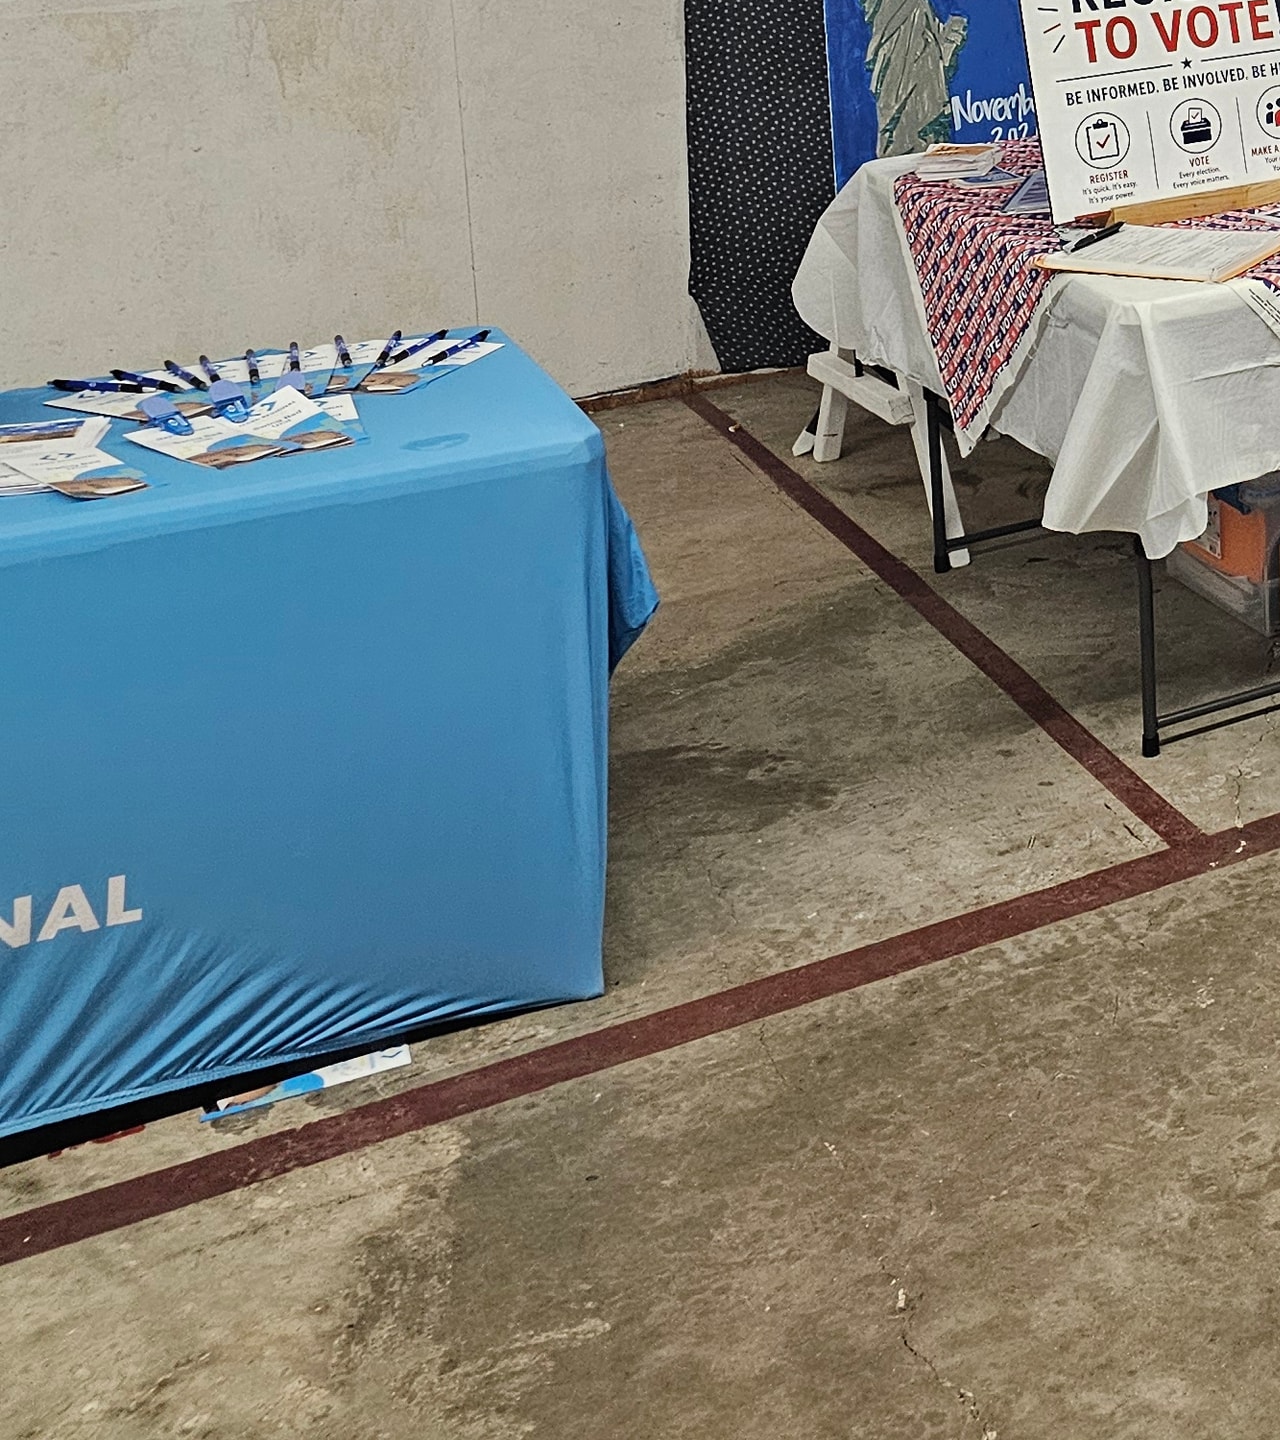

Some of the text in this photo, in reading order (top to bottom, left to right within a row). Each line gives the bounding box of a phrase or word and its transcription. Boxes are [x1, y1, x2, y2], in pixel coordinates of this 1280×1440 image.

[1074, 15, 1138, 63] TO
[1065, 90, 1083, 106] BE
[1086, 80, 1159, 102] INFORMED.
[1162, 77, 1180, 92] BE
[1182, 67, 1249, 91] INVOLVED.
[1252, 64, 1268, 79] BE
[951, 83, 1035, 131] Novemb
[1251, 144, 1272, 157] MAKE
[1274, 143, 1279, 154] A
[1188, 155, 1210, 168] VOTE
[1264, 155, 1277, 164] Your
[1089, 169, 1129, 185] REGISTER
[1179, 170, 1194, 180] Every
[1173, 179, 1188, 189] Every
[1190, 178, 1204, 187] voice
[1101, 193, 1114, 203] your
[1009, 248, 1031, 277] VOTE
[0, 874, 143, 949] NAL
